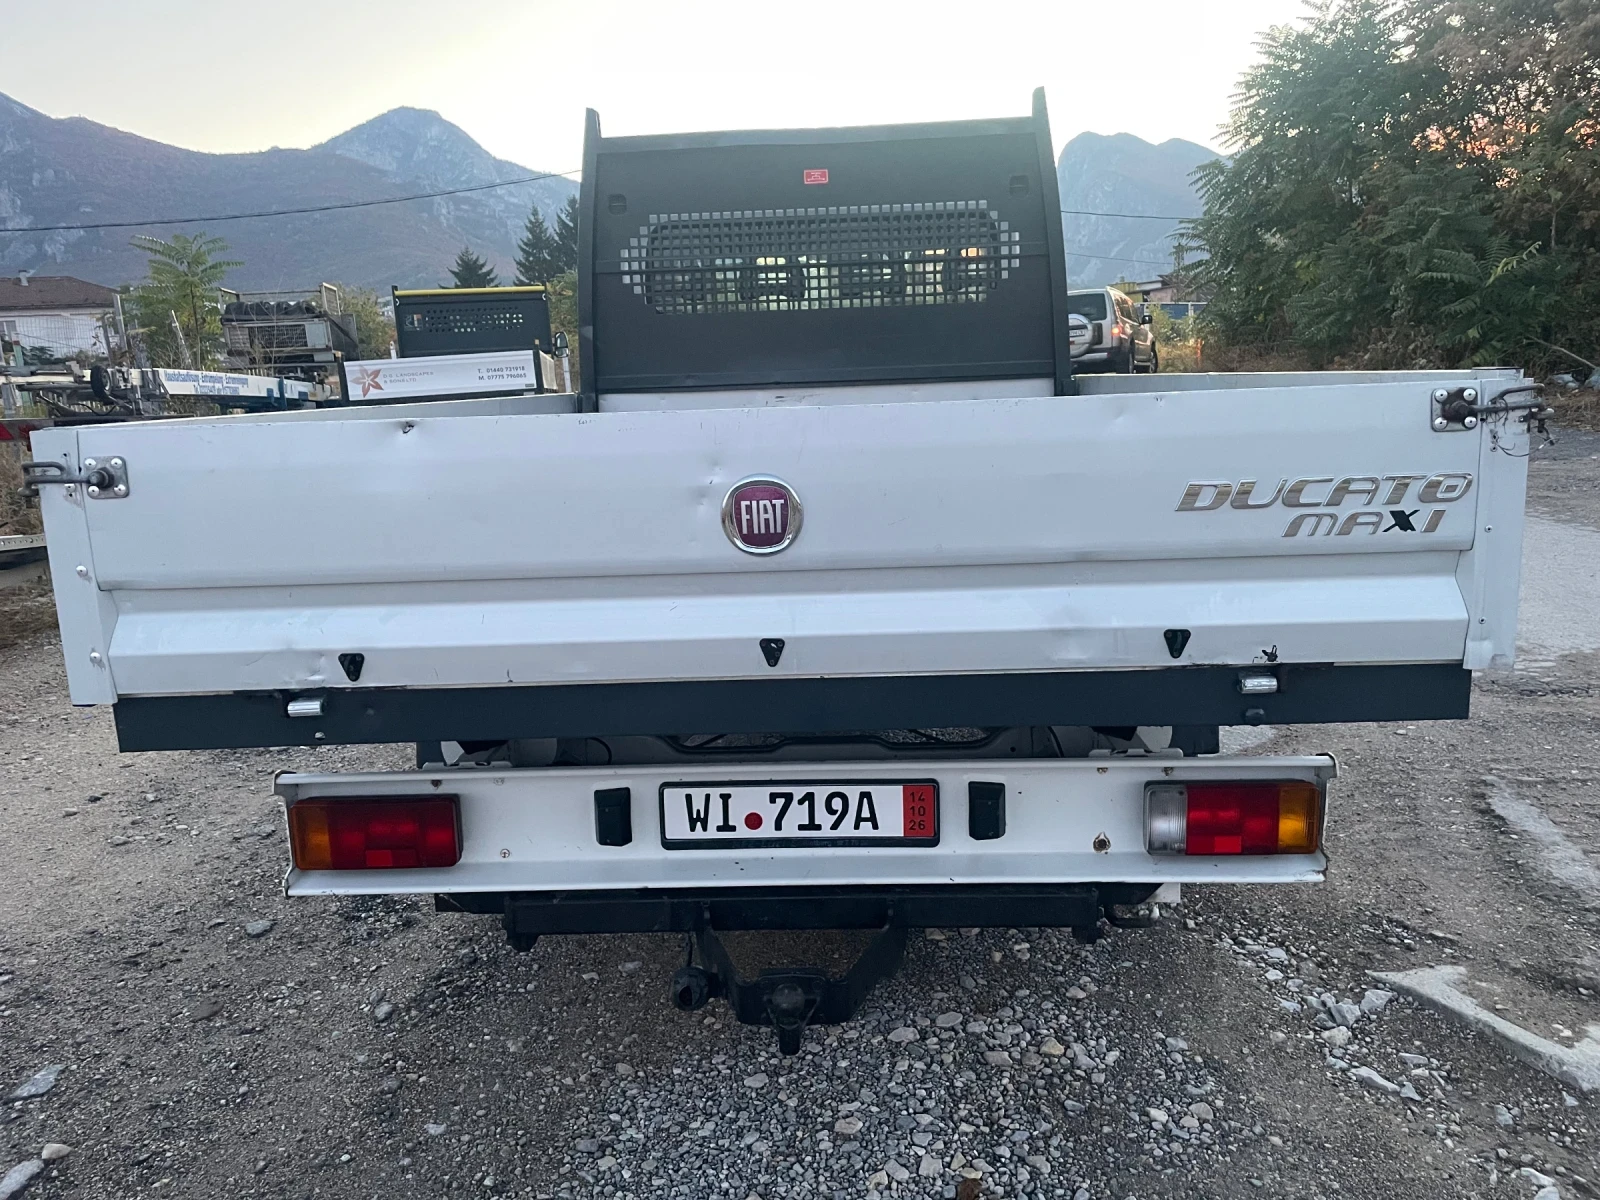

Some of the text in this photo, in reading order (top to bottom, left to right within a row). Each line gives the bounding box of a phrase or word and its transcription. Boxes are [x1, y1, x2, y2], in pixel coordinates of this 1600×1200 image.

[1174, 471, 1474, 512] DUCATO
[740, 499, 785, 535] FIAT
[1281, 507, 1447, 538] MAXI
[684, 790, 879, 833] WI 719A
[909, 791, 925, 803] 14
[909, 805, 926, 817] 10
[908, 819, 926, 831] 26
